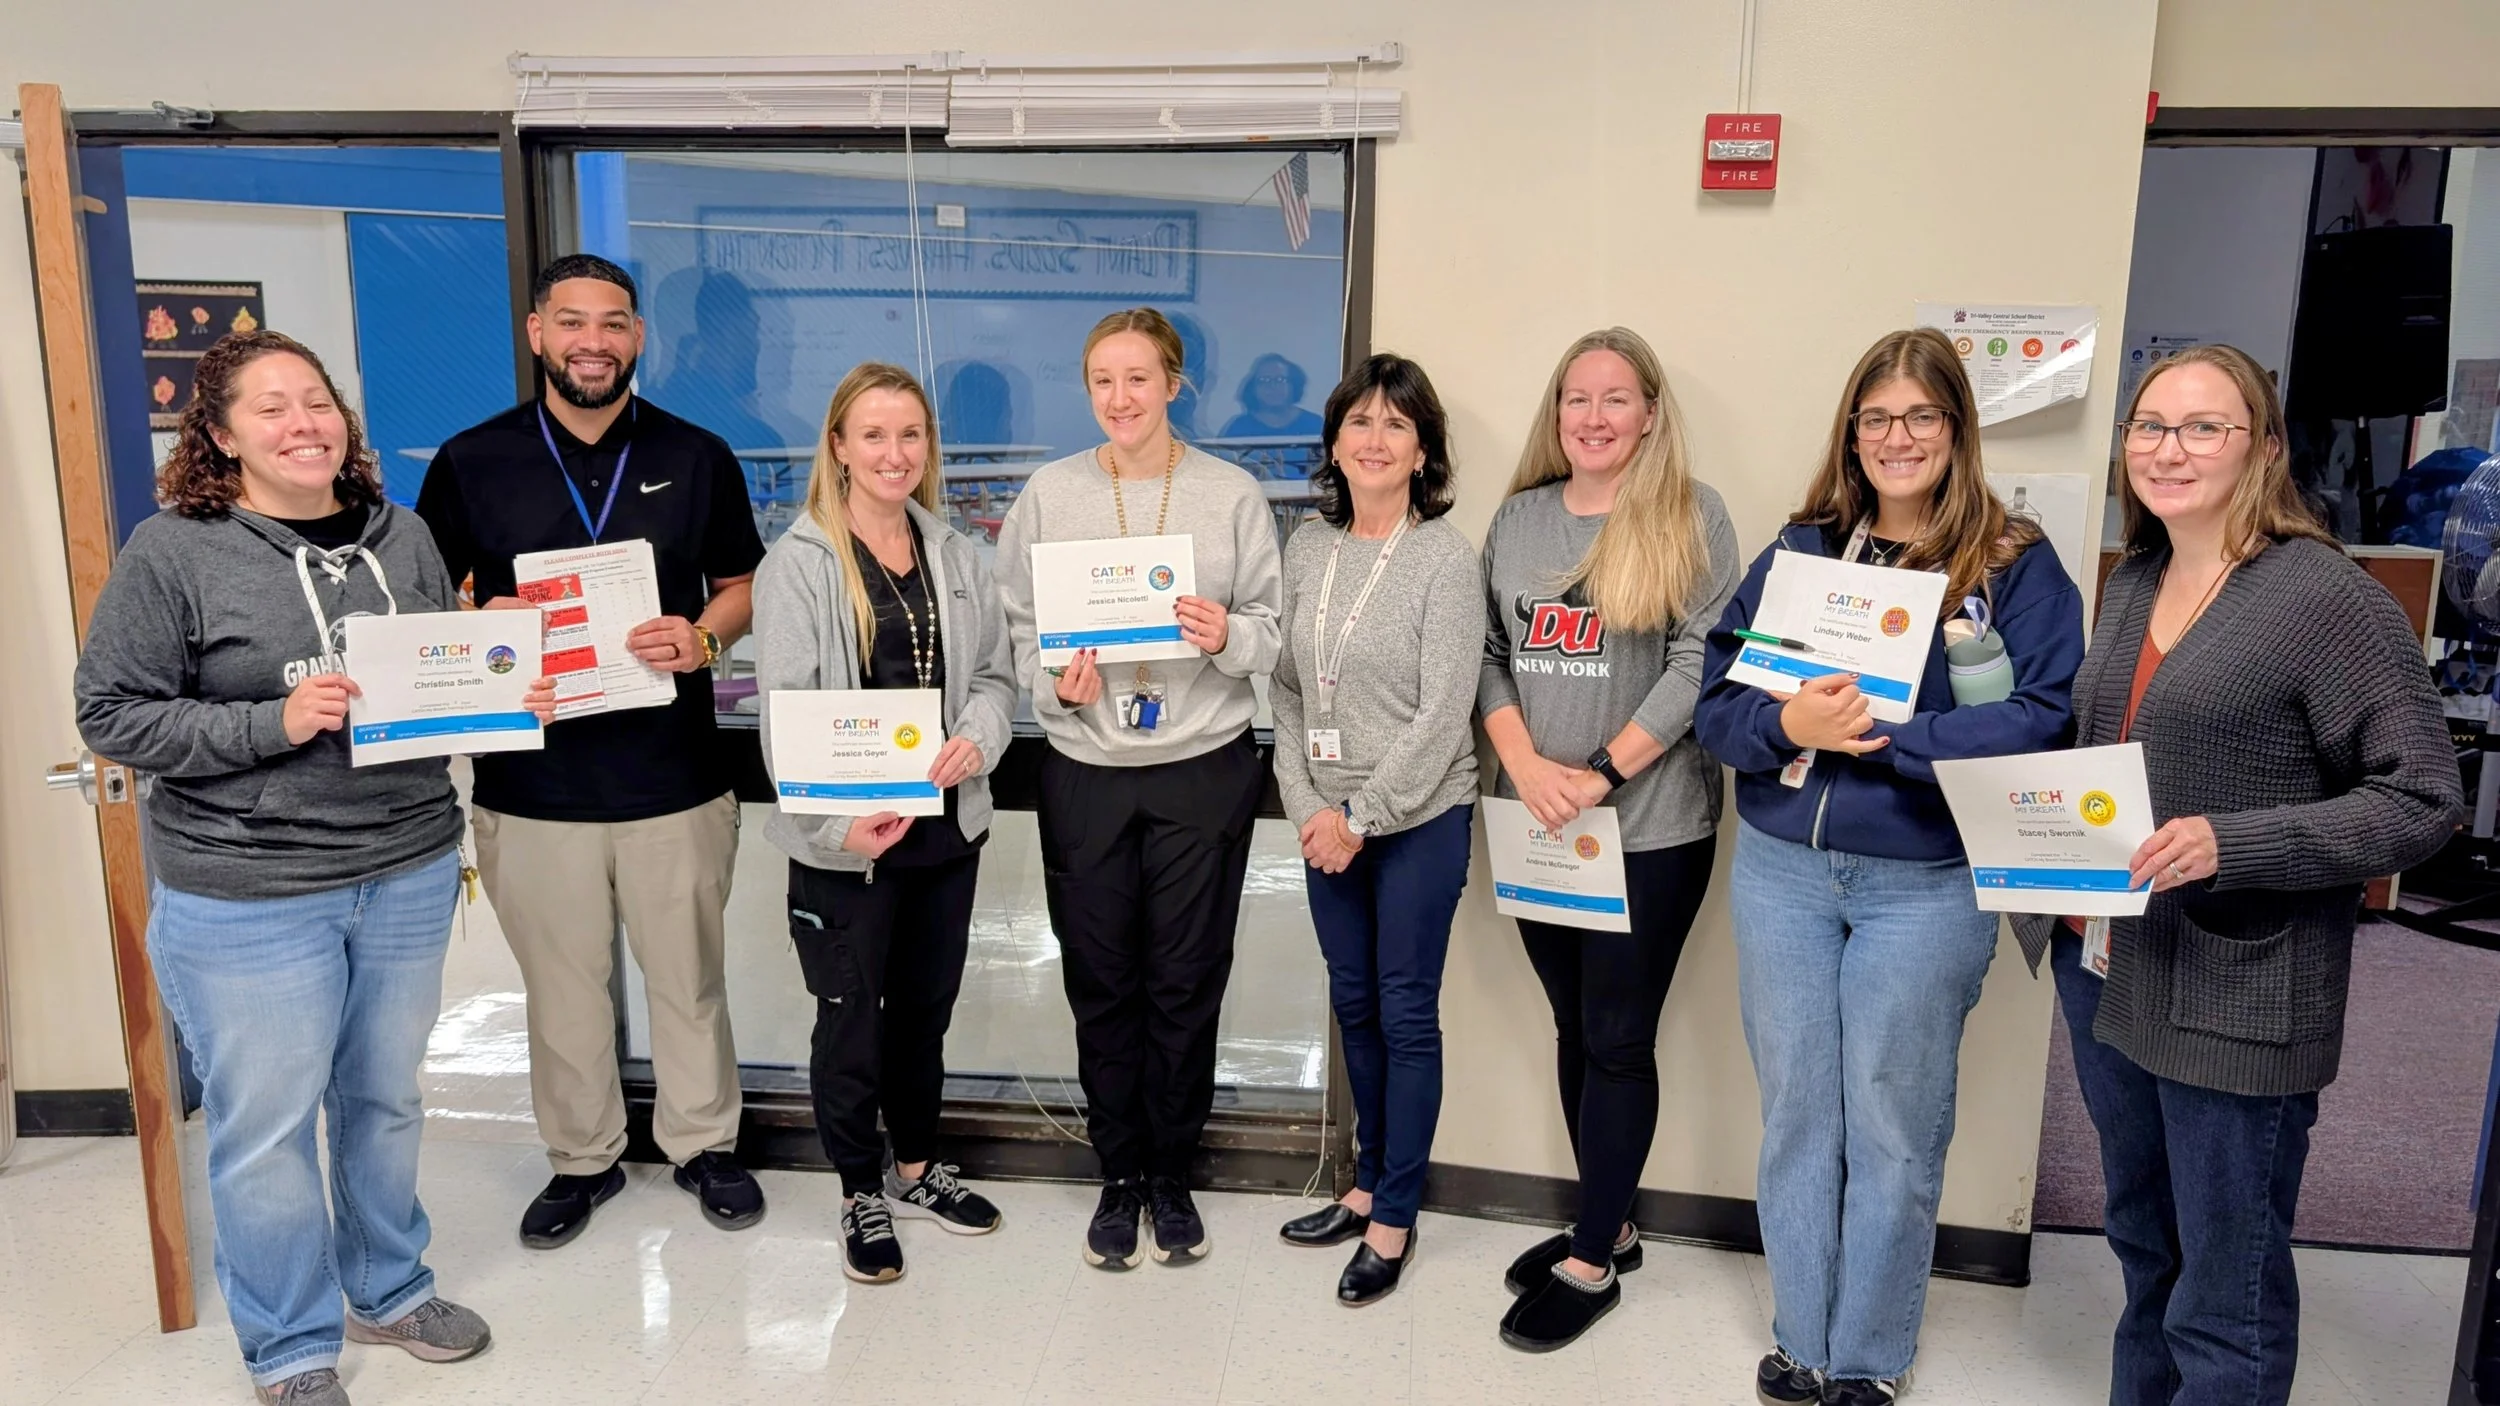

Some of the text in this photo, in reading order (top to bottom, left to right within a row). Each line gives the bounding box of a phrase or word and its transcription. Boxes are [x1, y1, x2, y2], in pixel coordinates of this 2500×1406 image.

[1724, 122, 1762, 133] FIRE
[1721, 170, 1759, 181] FIRE
[1091, 565, 1134, 578] CATCH
[1105, 577, 1136, 586] BREATH
[1086, 595, 1149, 606] Jessica Nicoletti
[1826, 592, 1872, 610] CATCH
[1824, 604, 1870, 619] MY BREATH
[1524, 603, 1602, 653] DU
[1813, 624, 1872, 644] Lindsay Weber
[419, 643, 470, 659] CATCH
[420, 655, 472, 667] MY BREATH
[283, 652, 348, 689] GRAHA
[1515, 658, 1611, 678] NEW YORK
[414, 676, 484, 690] Christina Smith
[833, 718, 879, 730] CATCH
[848, 730, 880, 738] BREATH
[831, 749, 888, 759] Jessica Geyer
[2009, 789, 2062, 805] CATCH
[2014, 804, 2066, 814] MY BREATH
[1528, 828, 1563, 843] CATCH
[2017, 828, 2087, 839] Stacey Swornik
[1530, 839, 1565, 850] MY BREATH
[1525, 857, 1580, 872] Andrea McGregor
